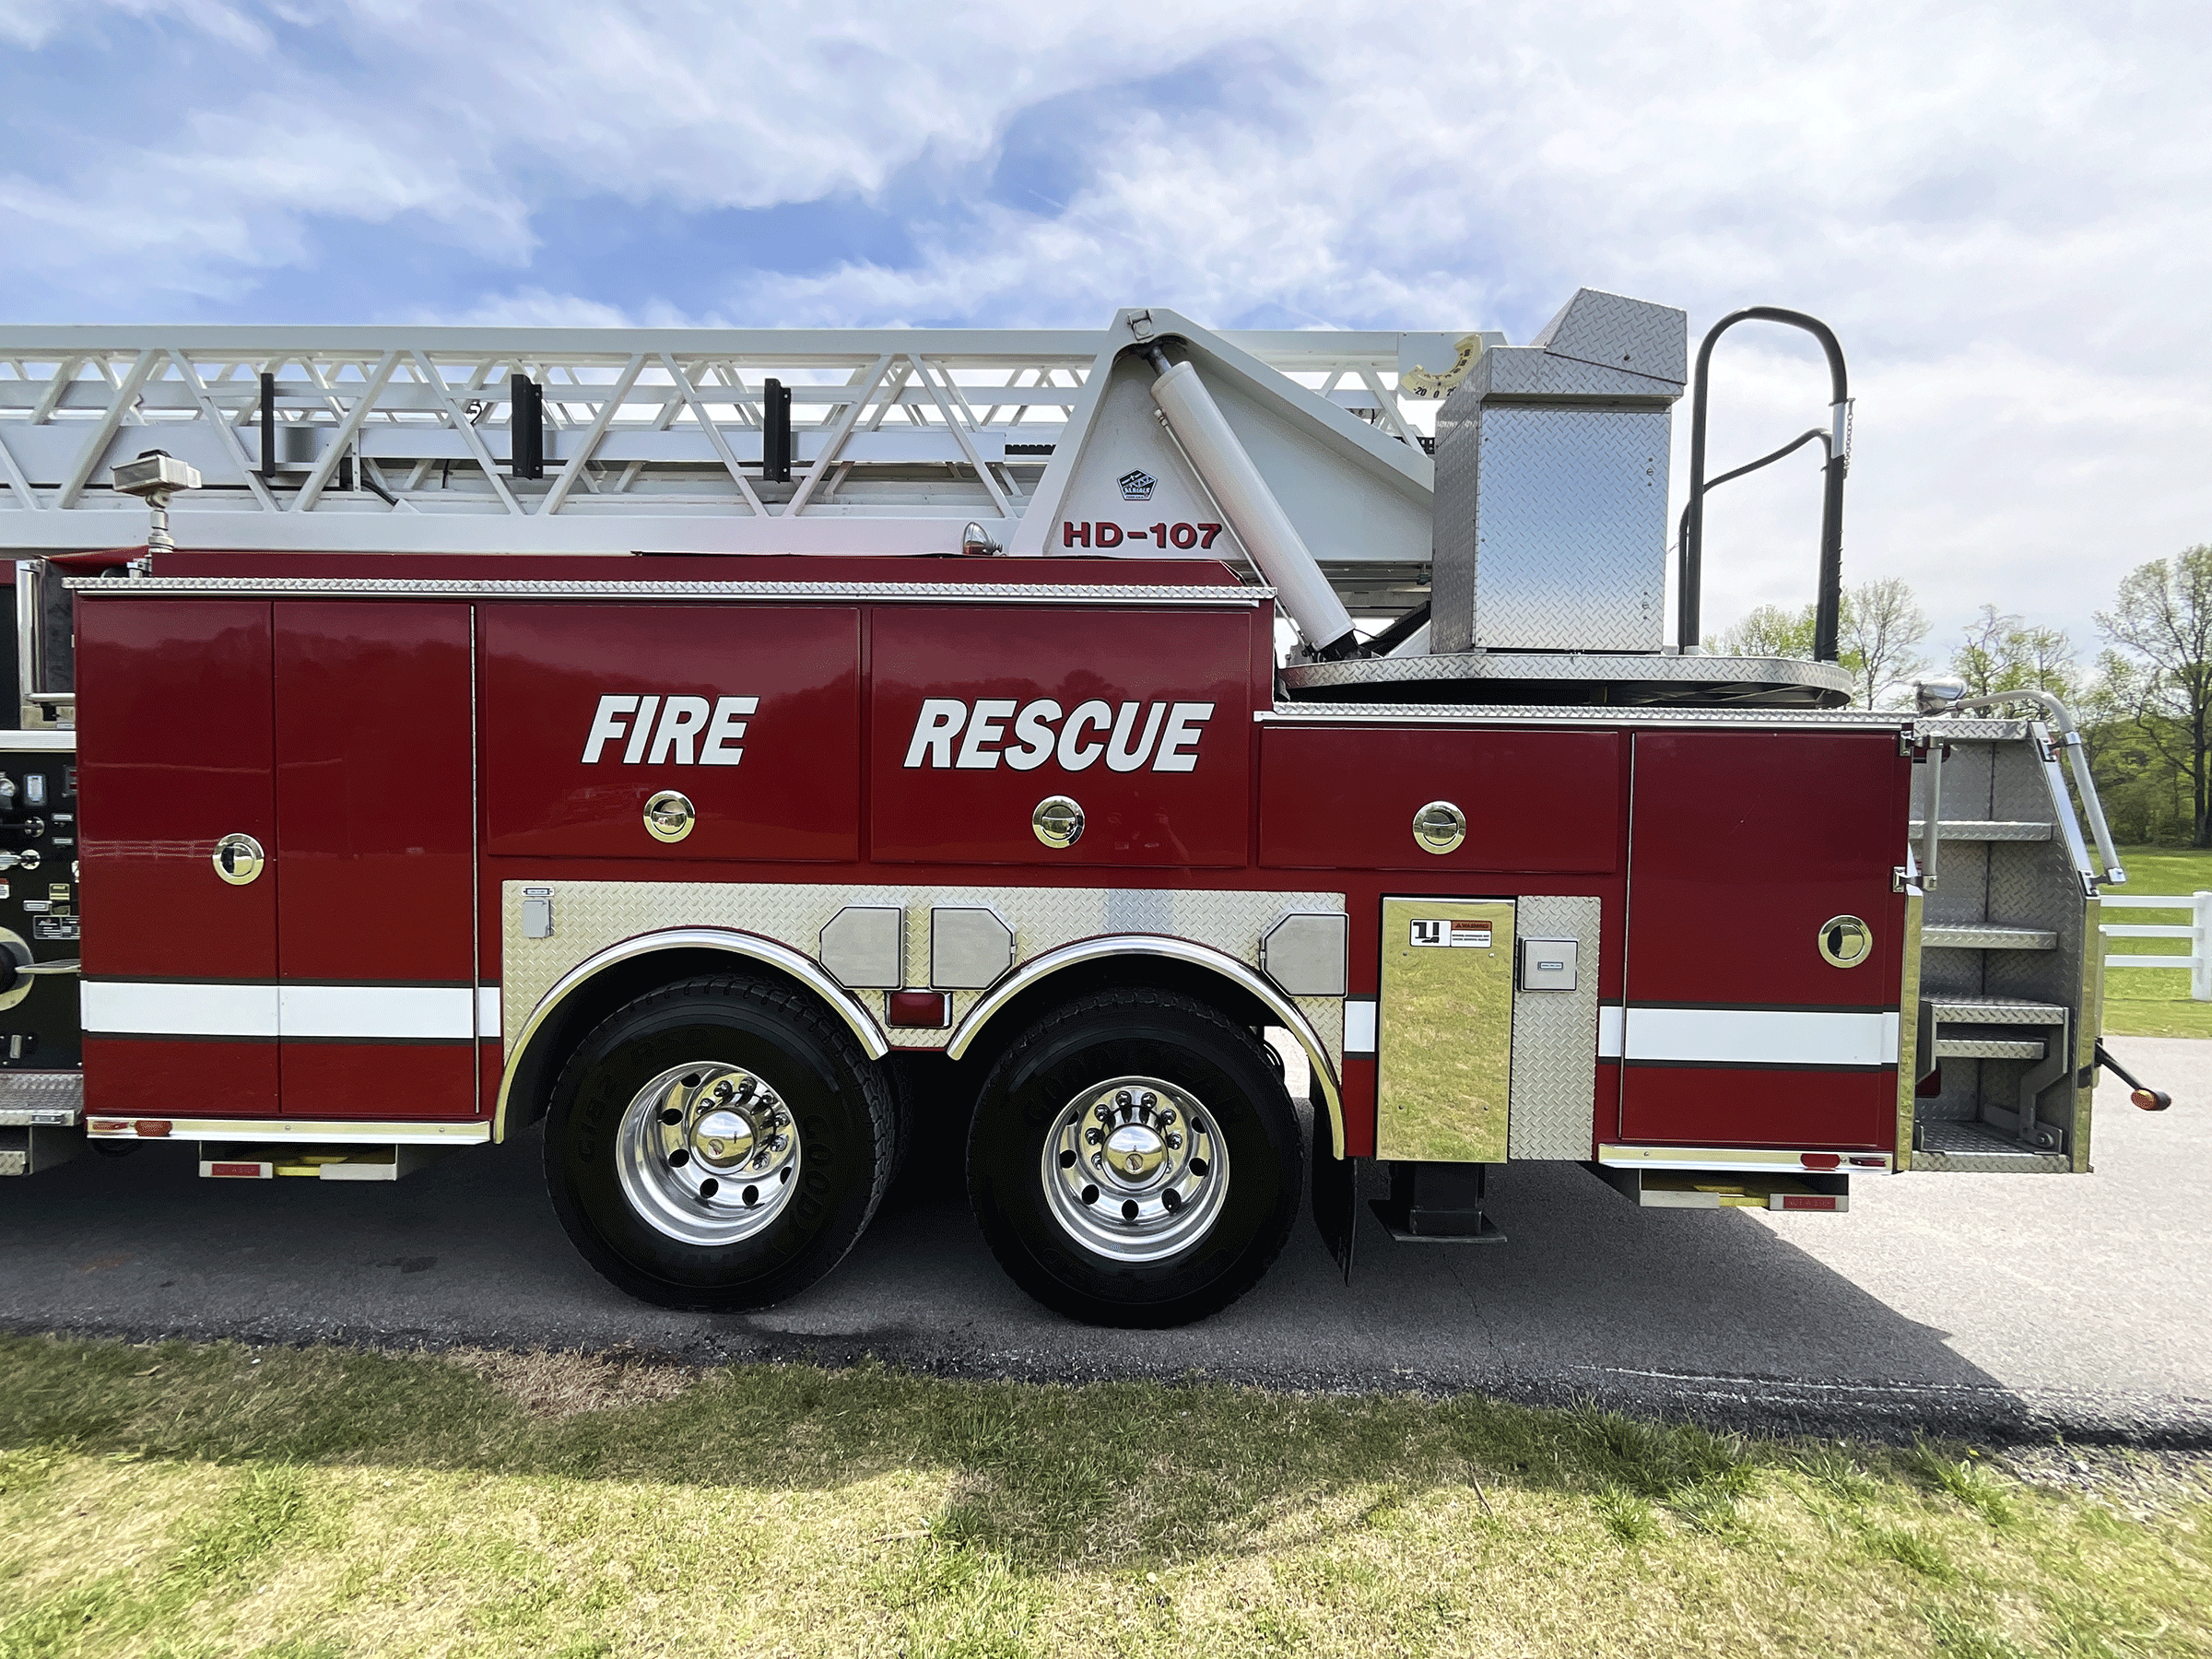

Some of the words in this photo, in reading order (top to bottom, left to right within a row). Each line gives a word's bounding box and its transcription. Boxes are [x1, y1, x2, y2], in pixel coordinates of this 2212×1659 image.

[1413, 387, 1427, 396] -20
[1433, 390, 1440, 398] 0
[1063, 522, 1223, 550] HD-107
[580, 693, 760, 767] FIRE
[902, 697, 1216, 774] RESCUE
